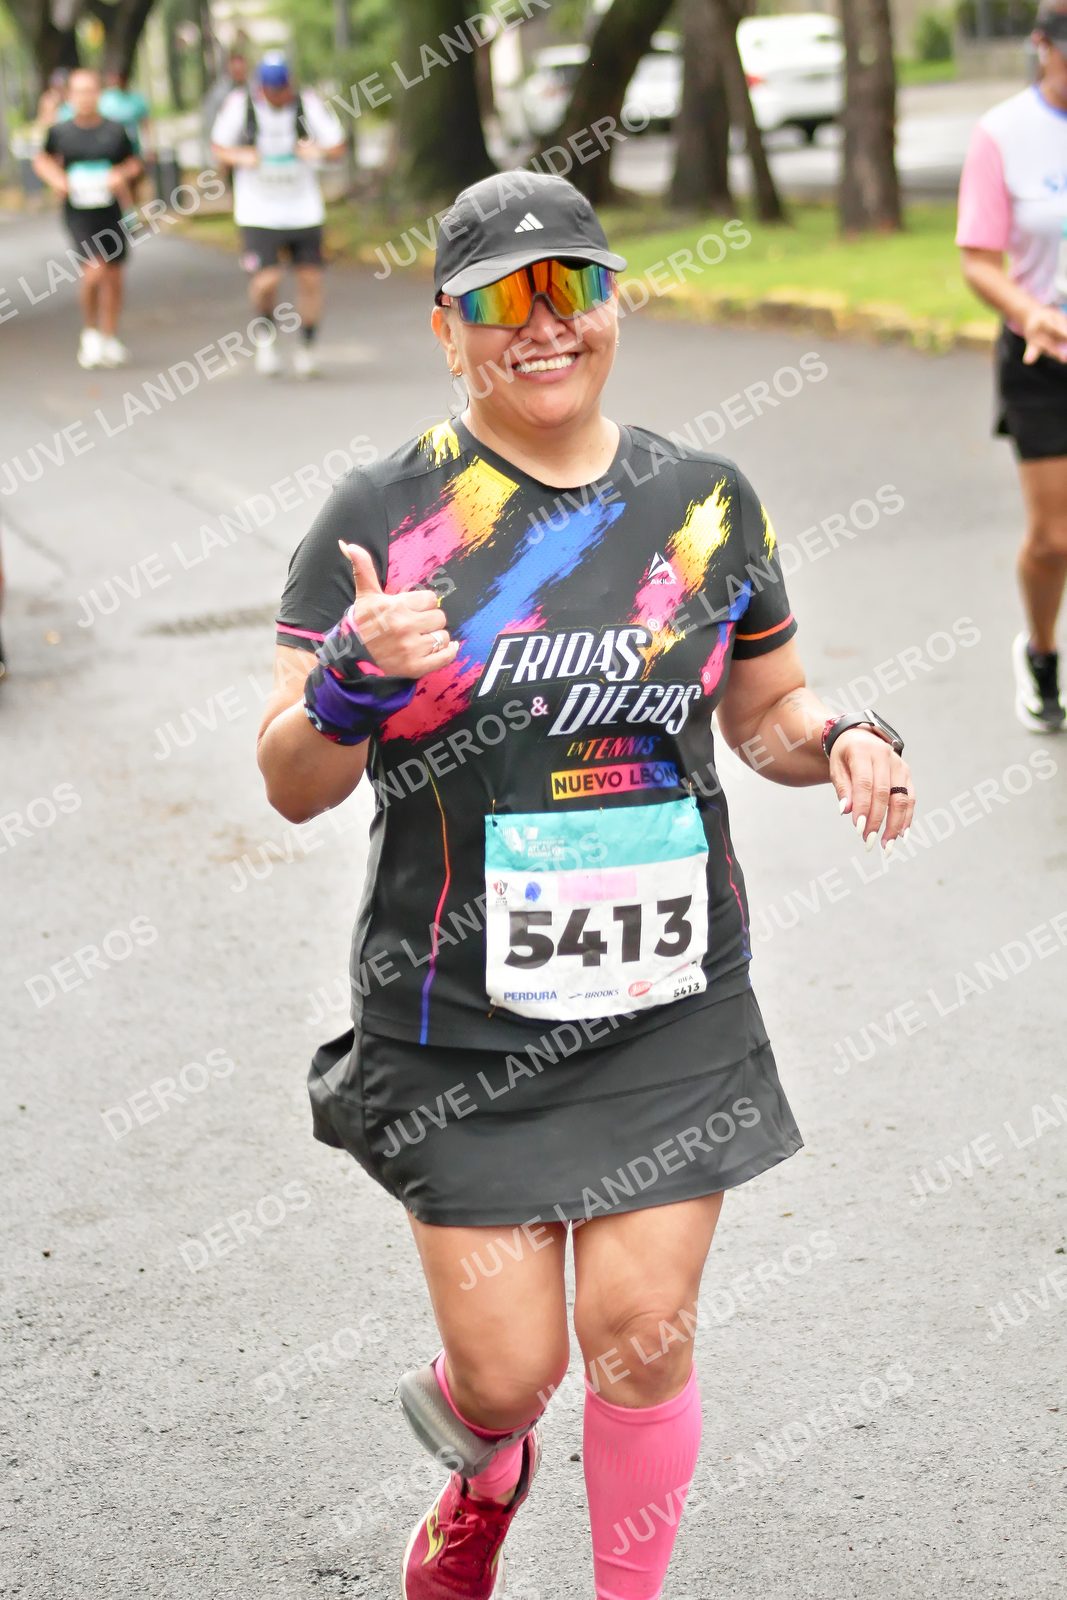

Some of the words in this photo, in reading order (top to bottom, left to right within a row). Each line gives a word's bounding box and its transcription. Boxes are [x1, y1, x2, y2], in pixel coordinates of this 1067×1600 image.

[477, 629, 647, 698] FRIDAS
[530, 695, 549, 718] &
[547, 683, 702, 736] DIEGOS
[566, 741, 585, 757] EN
[582, 735, 662, 762] TENNIS
[555, 771, 623, 795] NUEVO
[504, 894, 693, 971] 5413
[503, 989, 557, 1002] PERDURA
[584, 988, 620, 999] BROOKS
[673, 982, 700, 998] 5413
